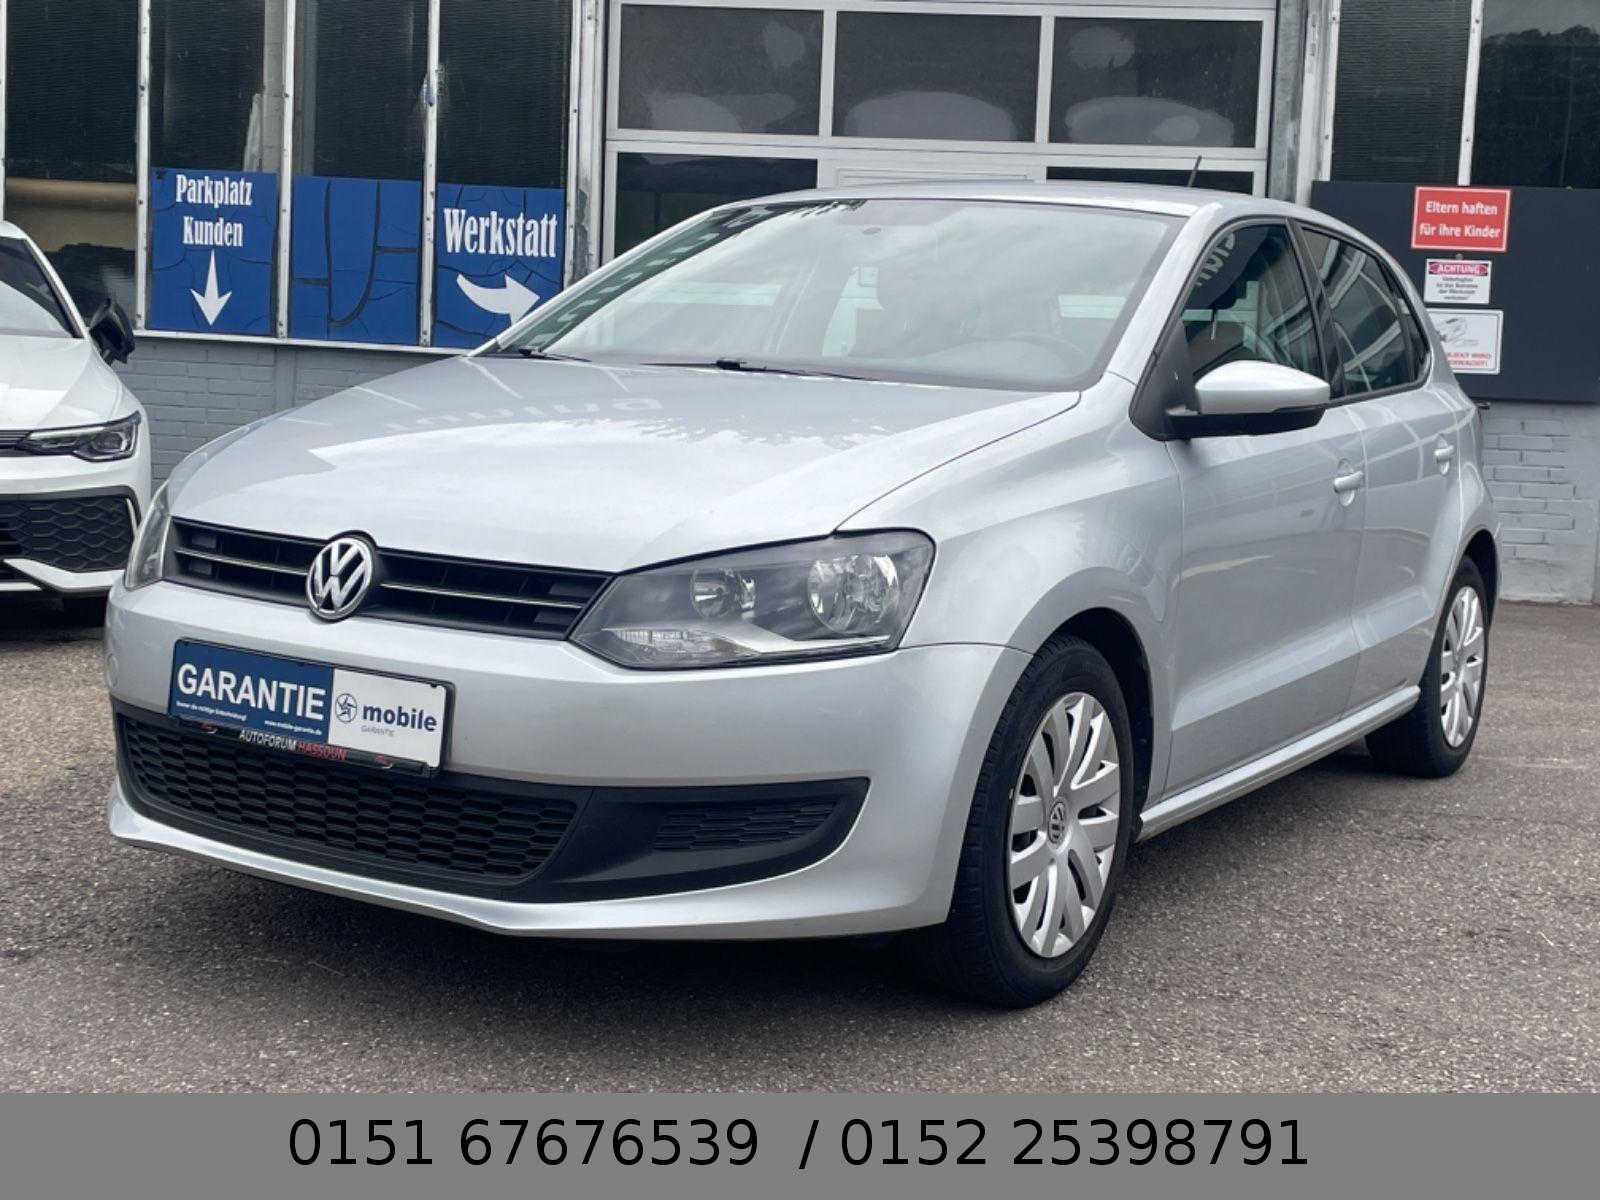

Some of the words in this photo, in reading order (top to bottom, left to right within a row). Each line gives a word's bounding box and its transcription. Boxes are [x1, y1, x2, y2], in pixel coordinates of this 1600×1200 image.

[176, 174, 253, 208] Parkplatz
[1425, 201, 1460, 214] Eltern
[1462, 201, 1498, 215] haften
[182, 216, 243, 247] Kunden
[443, 208, 558, 258] Werkstatt
[1419, 223, 1437, 236] für
[1464, 224, 1501, 238] Kinder
[1437, 263, 1480, 275] ACHTUNG
[177, 662, 327, 721] GARANTIE
[363, 705, 438, 733] mobile
[239, 729, 297, 752] AUTOFORUM
